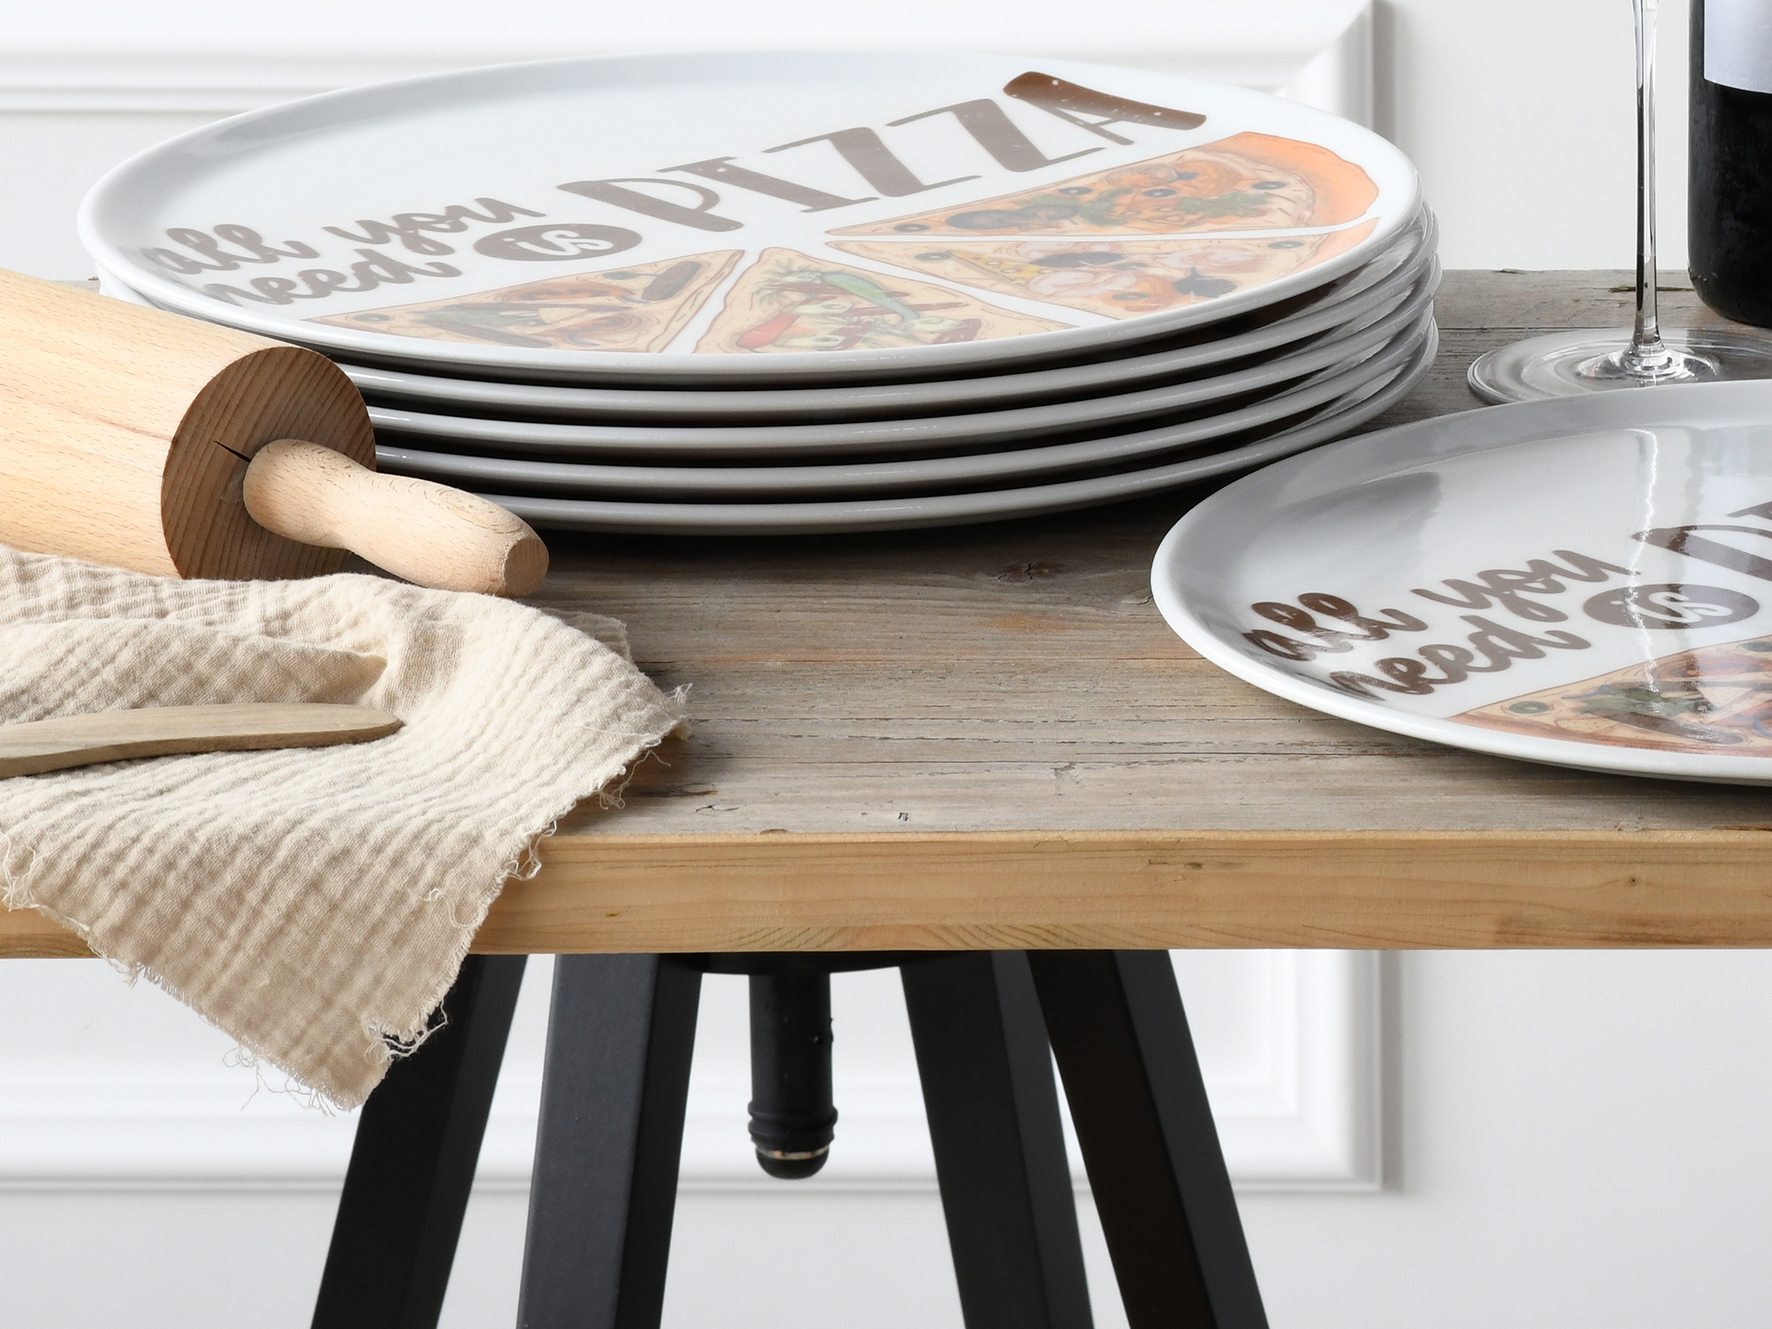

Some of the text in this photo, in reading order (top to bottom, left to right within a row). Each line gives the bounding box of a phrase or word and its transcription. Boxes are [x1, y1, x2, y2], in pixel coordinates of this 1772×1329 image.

[141, 197, 547, 276] all you
[201, 70, 1208, 306] need is PIZZA
[1242, 549, 1642, 661] all you
[1329, 614, 1593, 701] need
[1605, 588, 1739, 627] is
